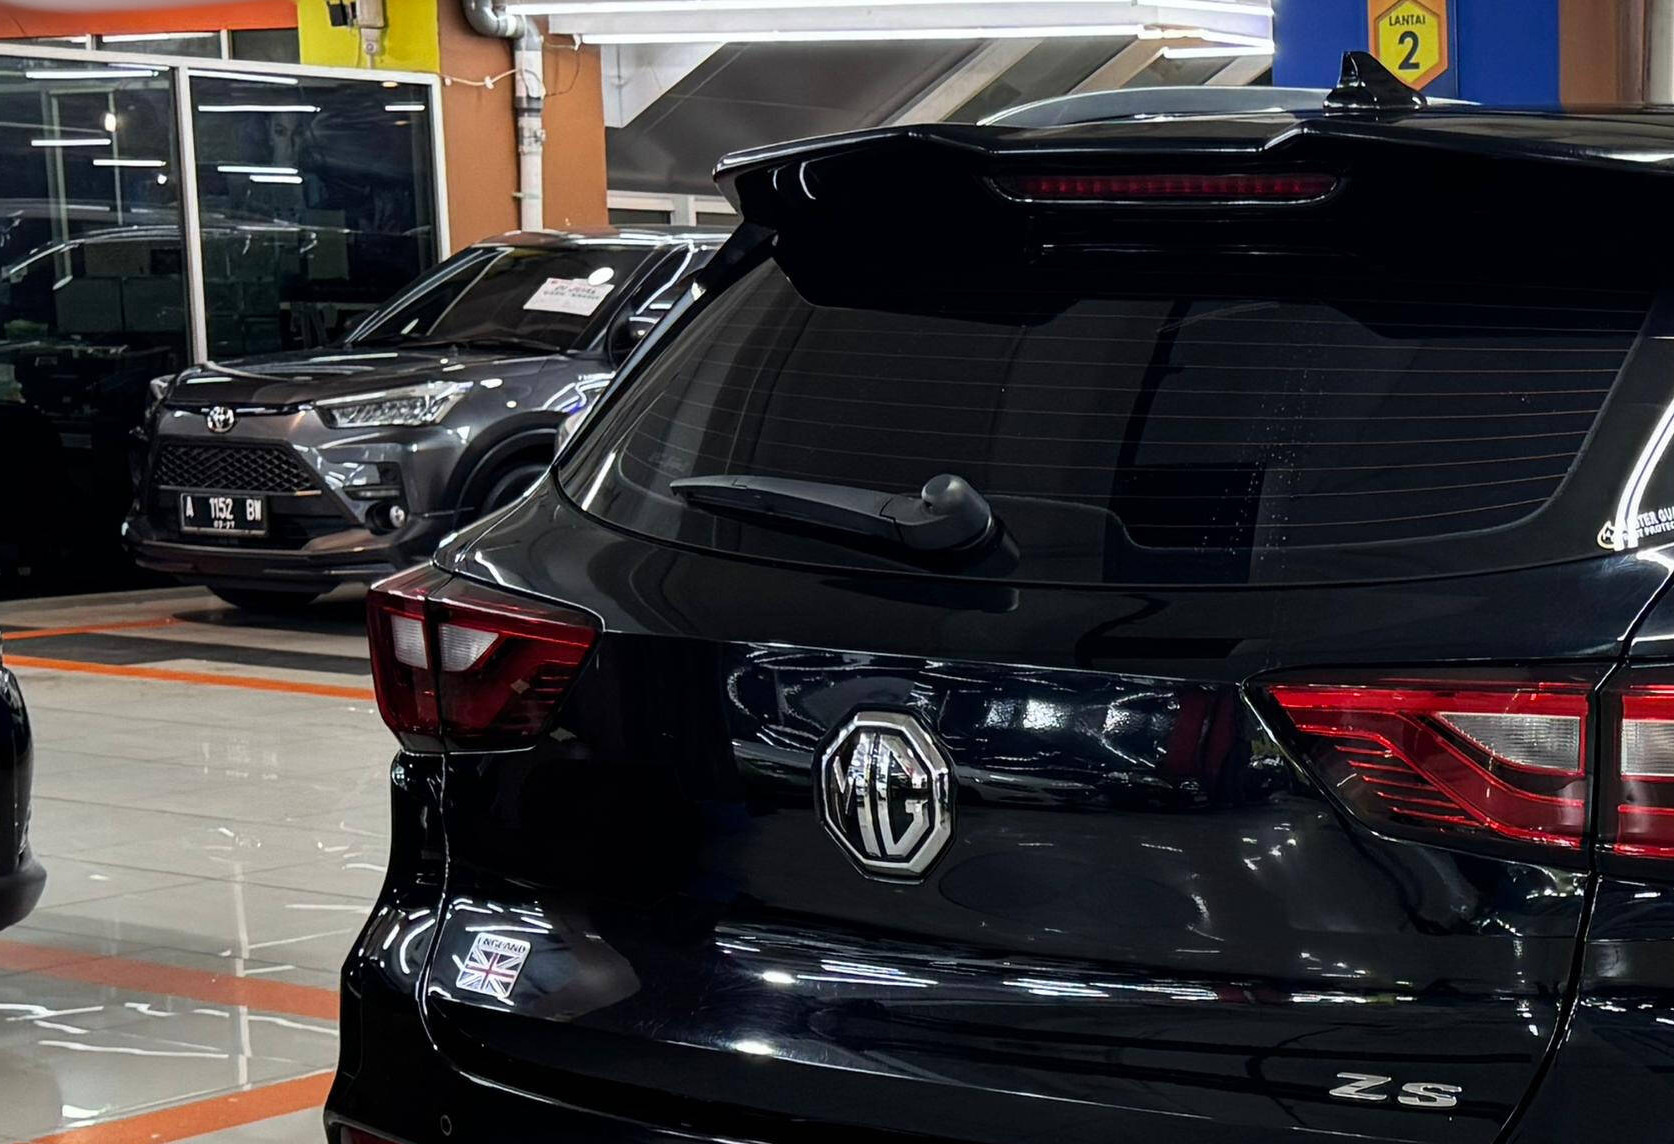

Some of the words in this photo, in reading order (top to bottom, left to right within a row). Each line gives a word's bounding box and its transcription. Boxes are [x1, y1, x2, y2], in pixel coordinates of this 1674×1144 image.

[1389, 14, 1426, 26] LANTAI
[1398, 31, 1420, 70] 2
[185, 495, 195, 519] A
[209, 497, 234, 520] 1152
[831, 730, 930, 859] MG
[1329, 1072, 1462, 1107] ZS
